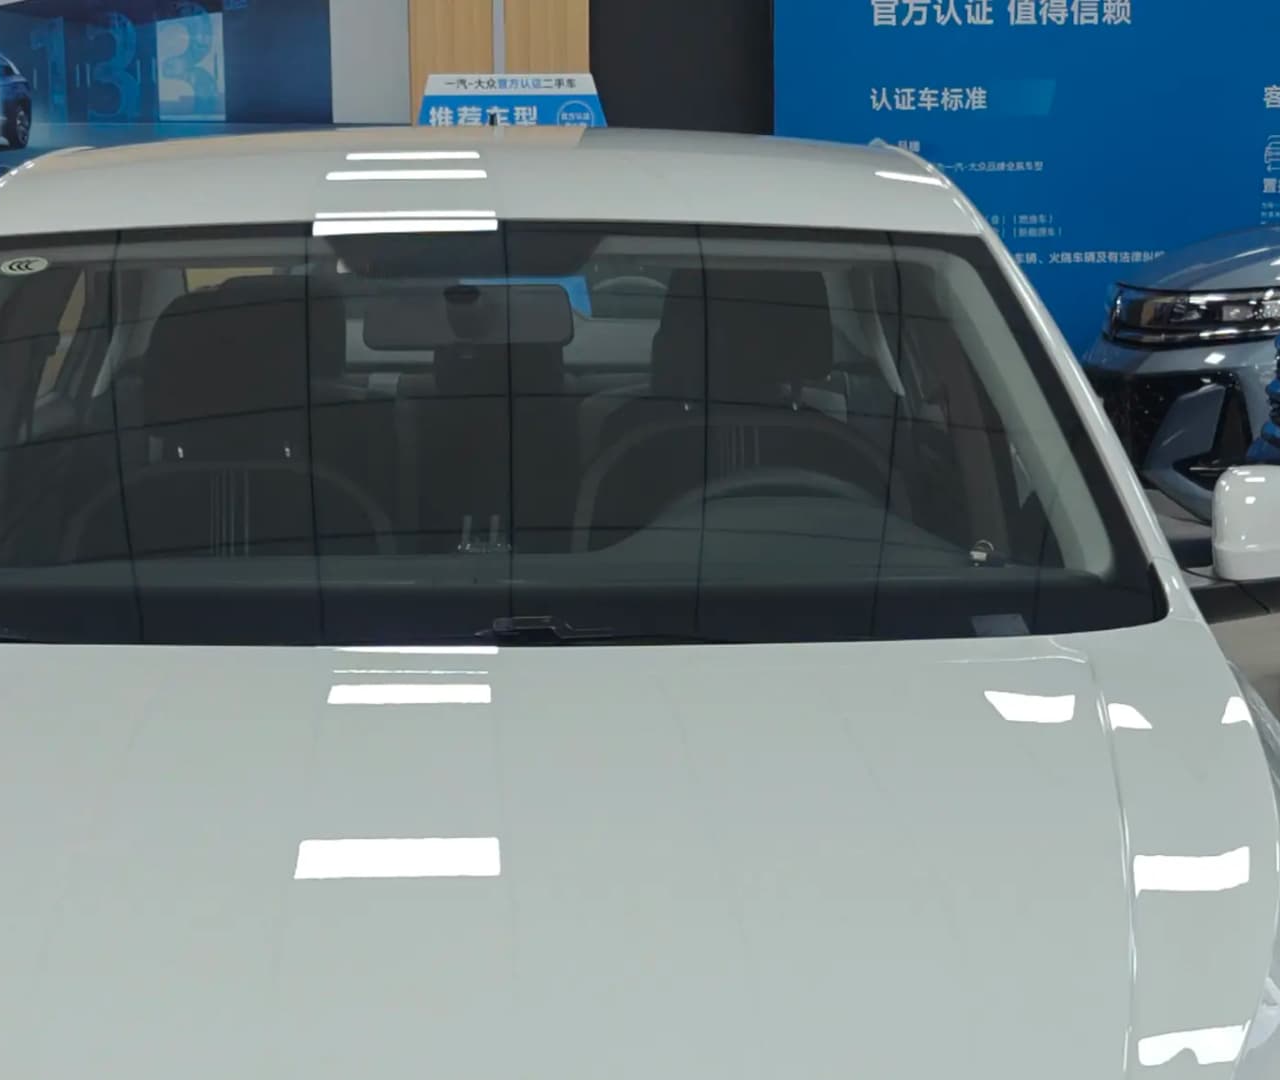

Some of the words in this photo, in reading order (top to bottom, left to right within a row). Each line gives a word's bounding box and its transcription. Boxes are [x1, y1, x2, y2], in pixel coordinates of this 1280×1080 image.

[871, 0, 993, 26] 官方认证
[1008, 0, 1132, 25] 值得信赖
[445, 78, 576, 89] 一汽-大众官方认证二手车
[870, 87, 987, 111] 认证车标准
